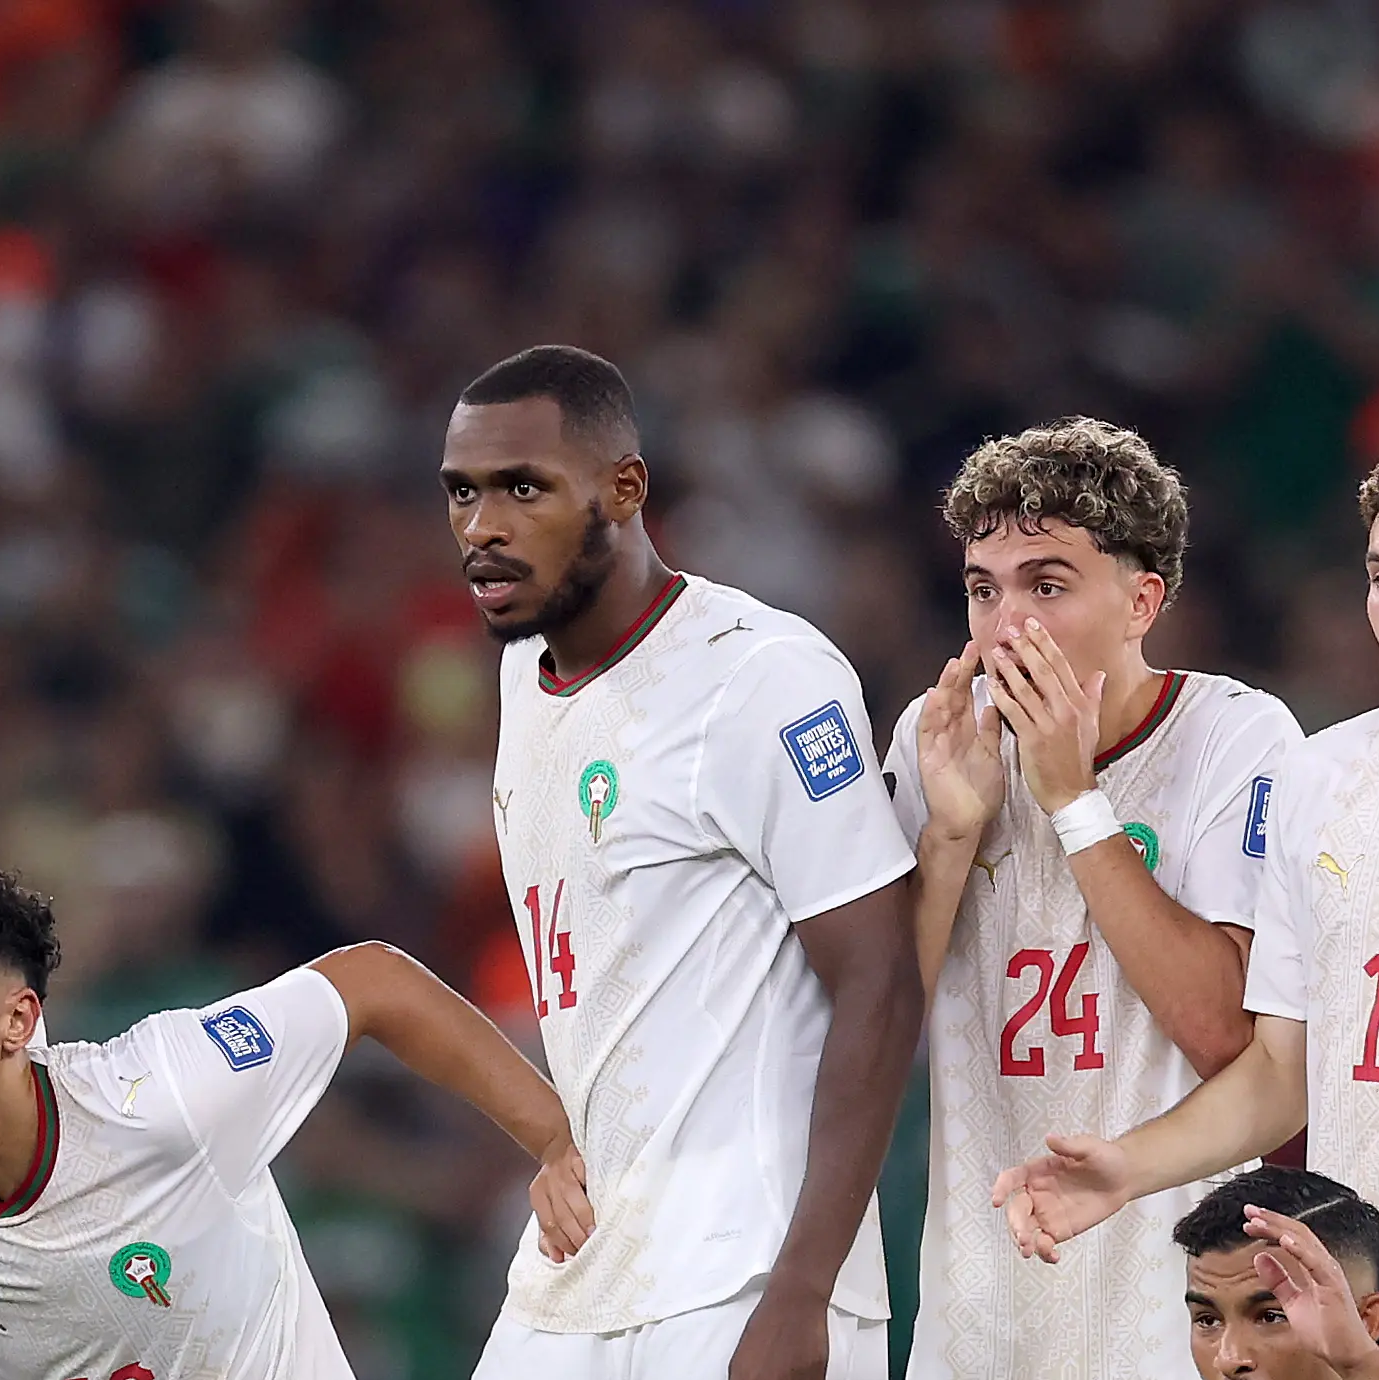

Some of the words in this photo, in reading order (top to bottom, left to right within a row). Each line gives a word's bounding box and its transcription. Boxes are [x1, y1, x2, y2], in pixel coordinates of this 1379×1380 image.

[795, 717, 839, 747] FOOTBALL
[801, 728, 846, 762] UNITES
[807, 760, 827, 778] the
[824, 741, 853, 769] World
[827, 765, 848, 780] FIFA
[523, 878, 577, 1019] 14
[999, 941, 1104, 1077] 24
